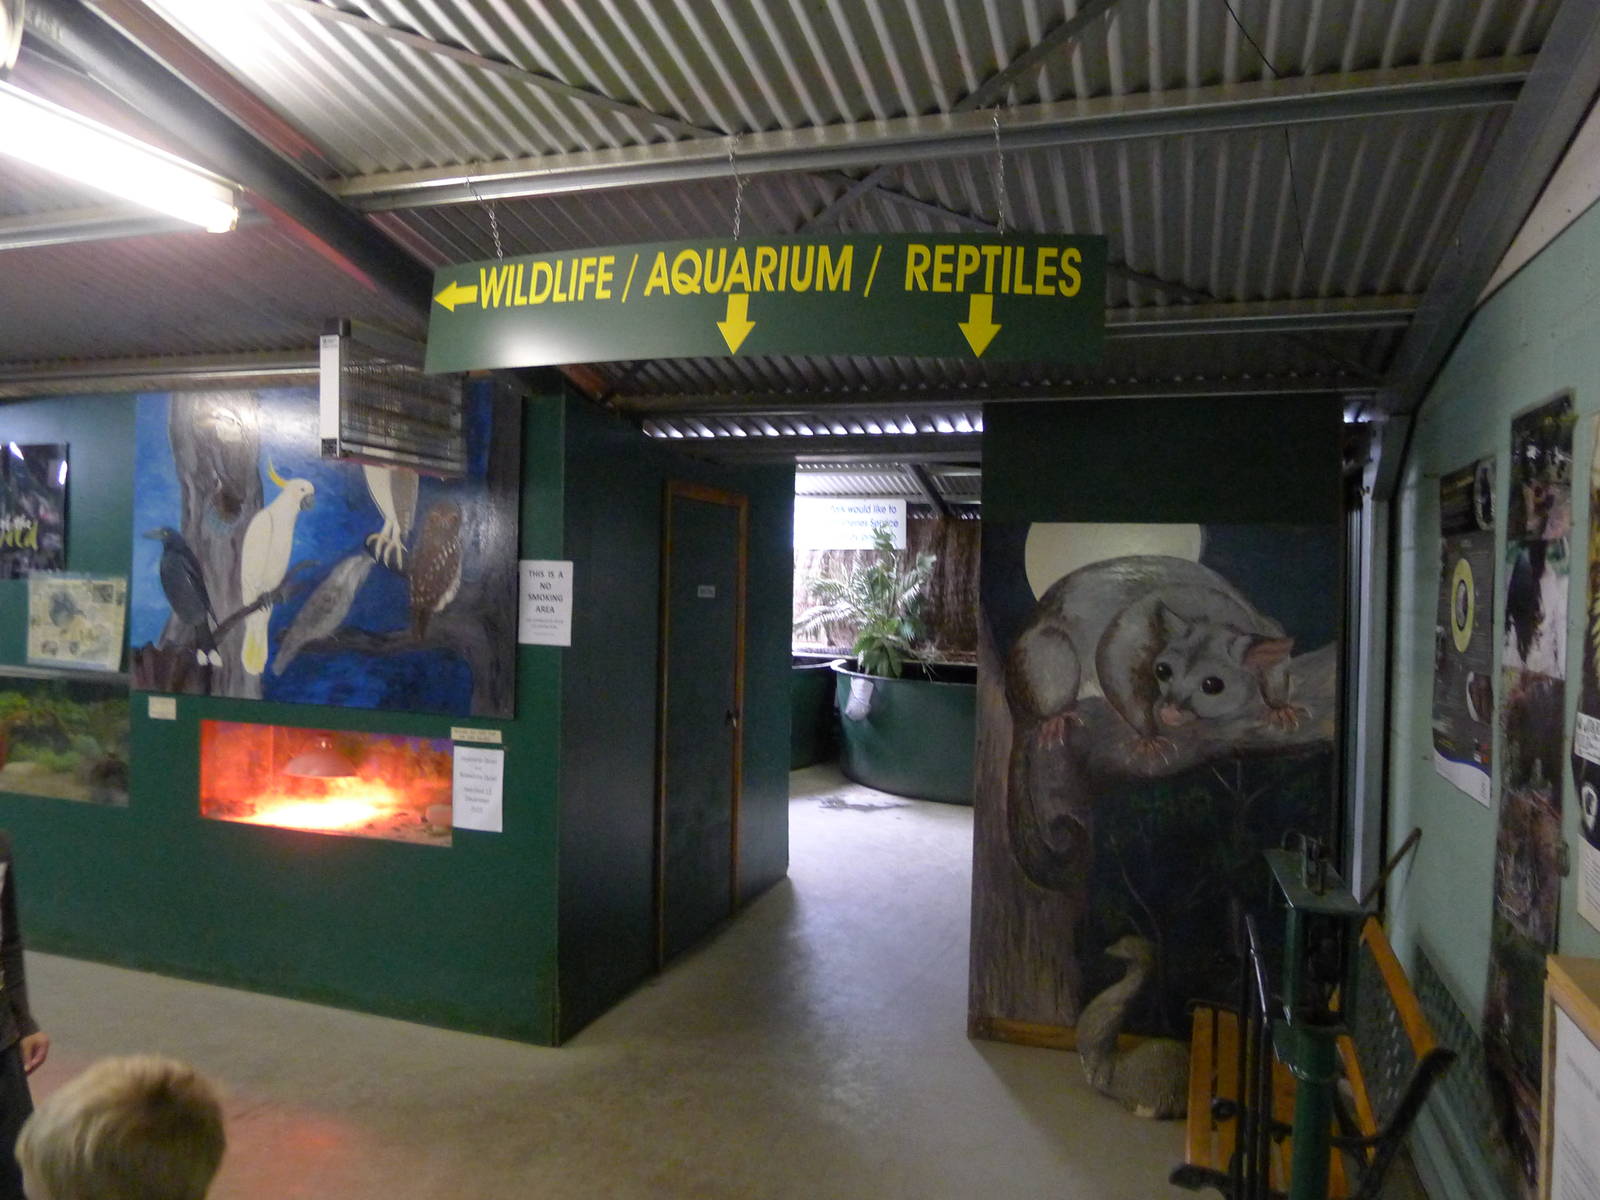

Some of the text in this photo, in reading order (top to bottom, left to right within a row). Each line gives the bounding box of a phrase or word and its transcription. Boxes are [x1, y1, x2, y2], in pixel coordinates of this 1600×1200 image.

[480, 255, 615, 310] WILDLIFE
[643, 244, 854, 297] AQUARIUM
[904, 243, 1082, 297] REPTILES
[847, 504, 872, 514] would
[873, 504, 887, 514] like
[888, 504, 897, 514] to
[528, 569, 565, 579] THIS IS A
[539, 582, 552, 590] NO
[527, 593, 564, 602] SMOKING
[535, 605, 556, 614] AREA
